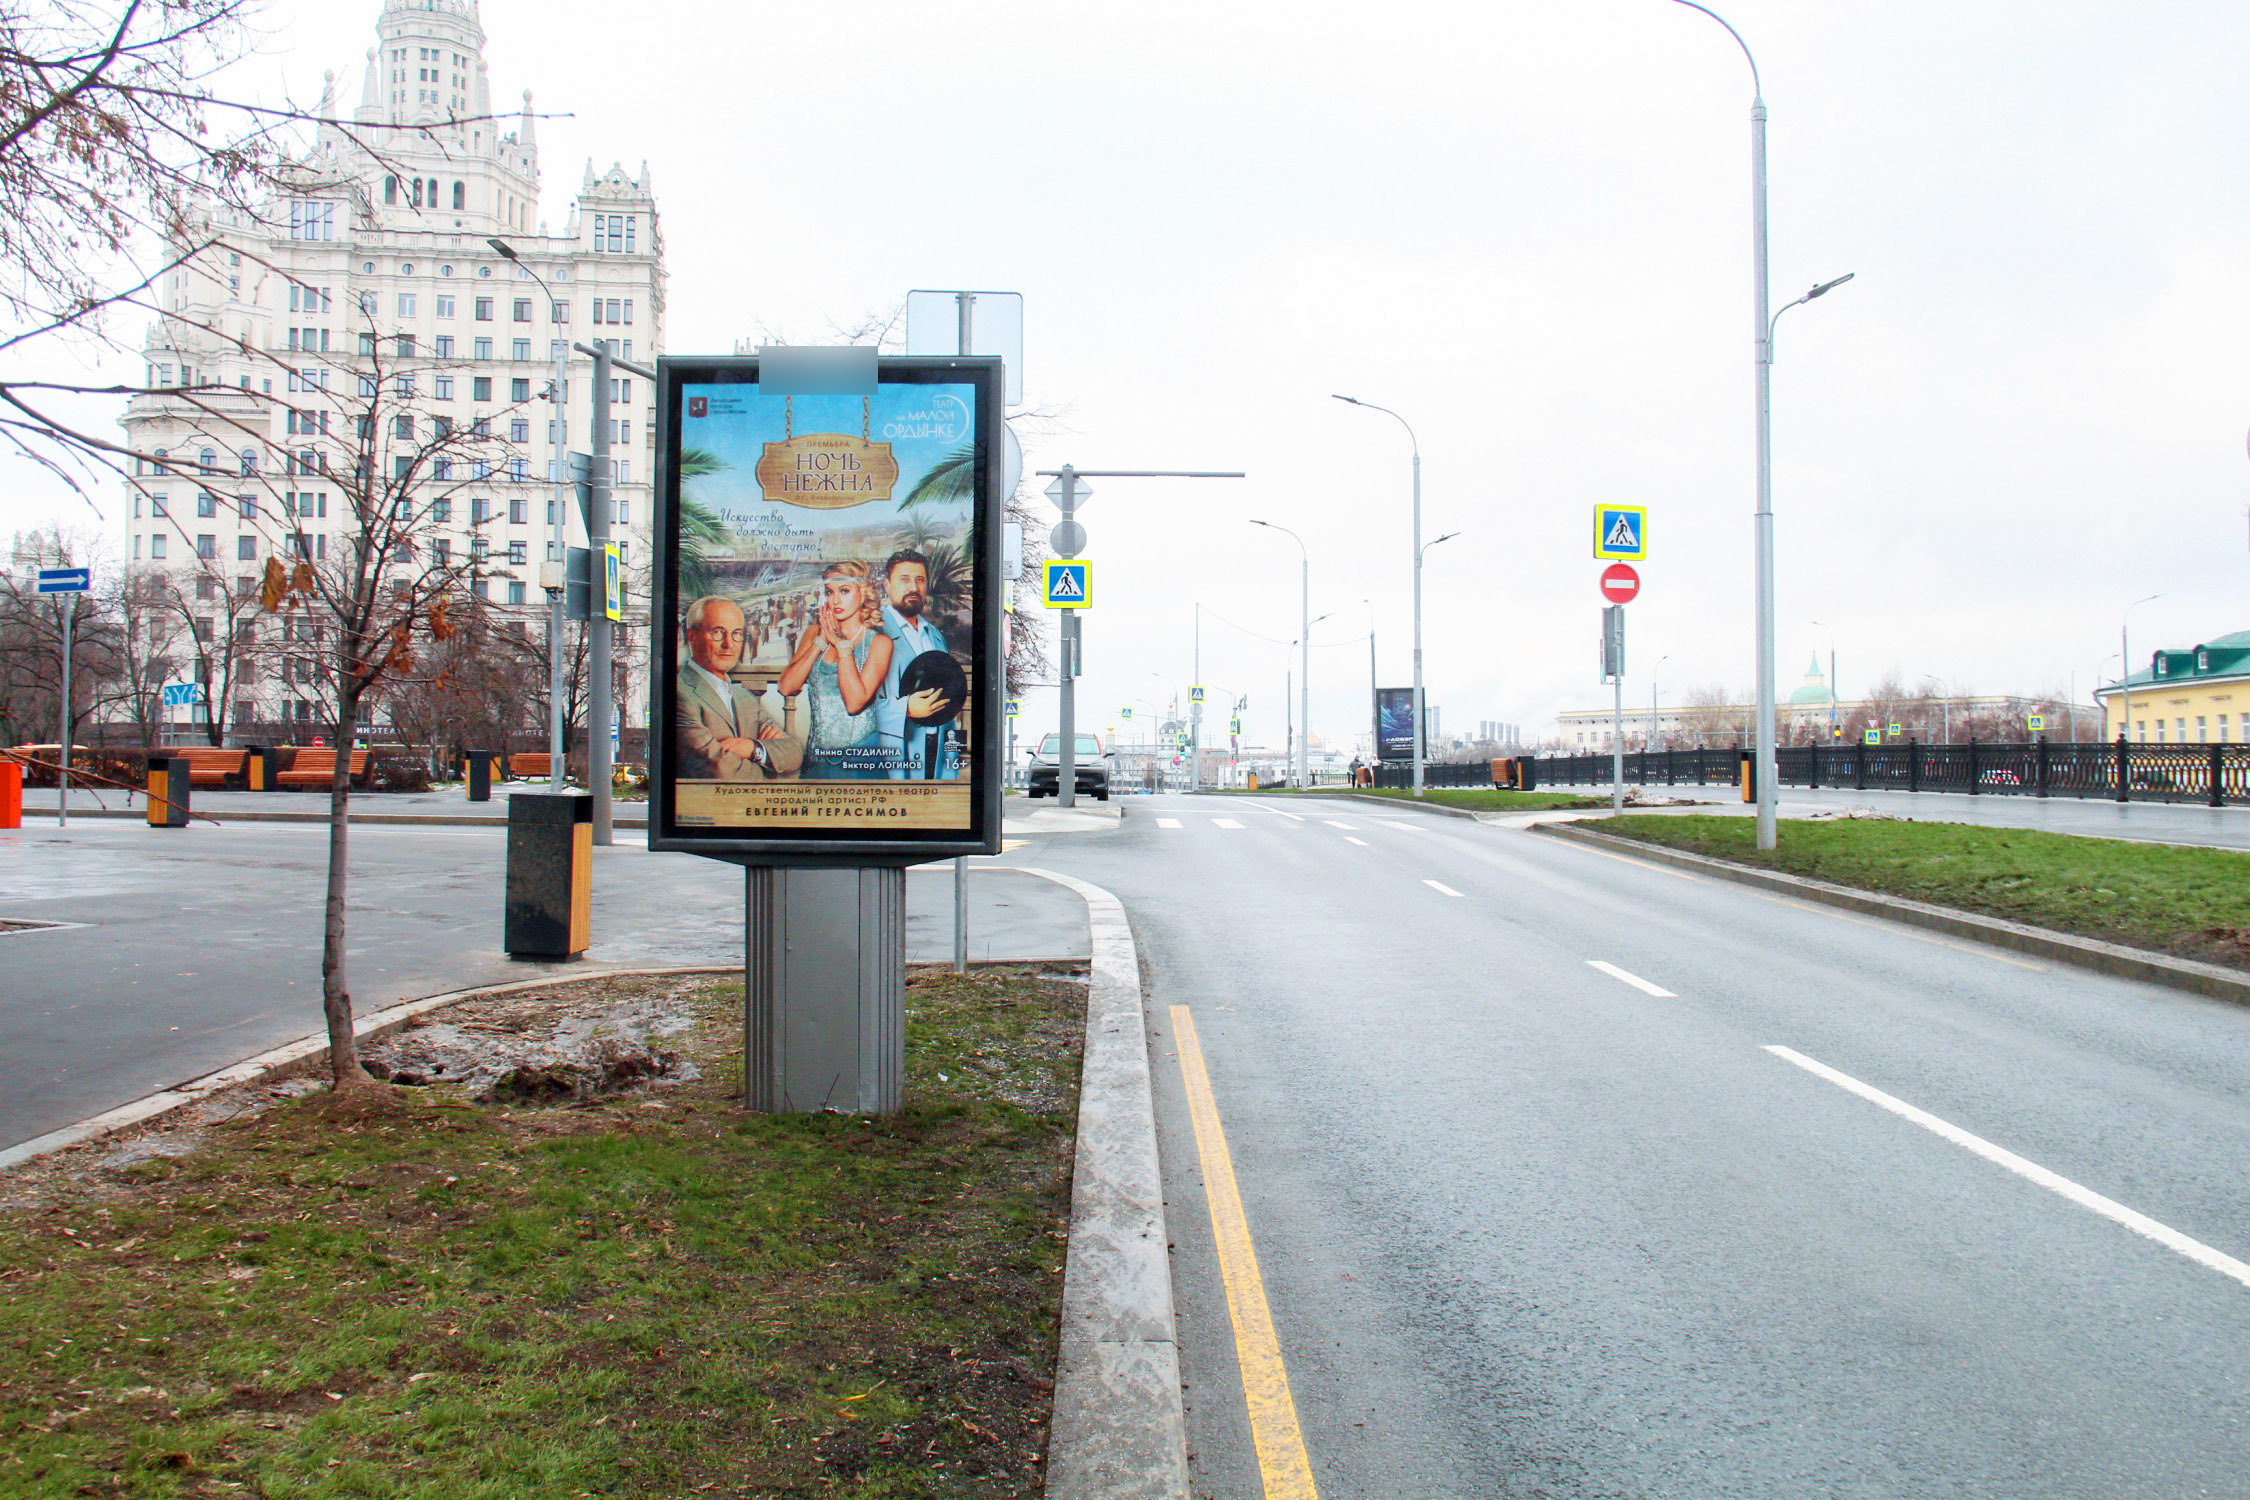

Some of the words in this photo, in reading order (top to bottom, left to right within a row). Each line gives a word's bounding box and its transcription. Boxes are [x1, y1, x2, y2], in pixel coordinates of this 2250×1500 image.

[883, 423, 955, 439] ОРДЫНКЕ
[806, 440, 850, 448] ПРЕМЬЕРА
[796, 452, 861, 471] НОЧЬ
[783, 473, 874, 492] НЕЖНА
[720, 507, 784, 525] Искусство
[736, 524, 781, 537] должно
[784, 523, 816, 537] быть
[761, 537, 822, 552] доступно!
[814, 748, 843, 756] Янина
[845, 748, 902, 757] СТУДИЛИНА
[842, 762, 876, 770] Виктор
[945, 758, 968, 770] 16+
[714, 786, 811, 796] Художественный
[815, 787, 894, 796] руководитель
[898, 787, 939, 796] театра
[766, 796, 823, 805] народный
[828, 797, 867, 806] артист
[872, 796, 887, 804] РФ
[745, 805, 809, 817] ЕВГЕНИЙ
[818, 807, 908, 817] ГЕРАСИМОВ
